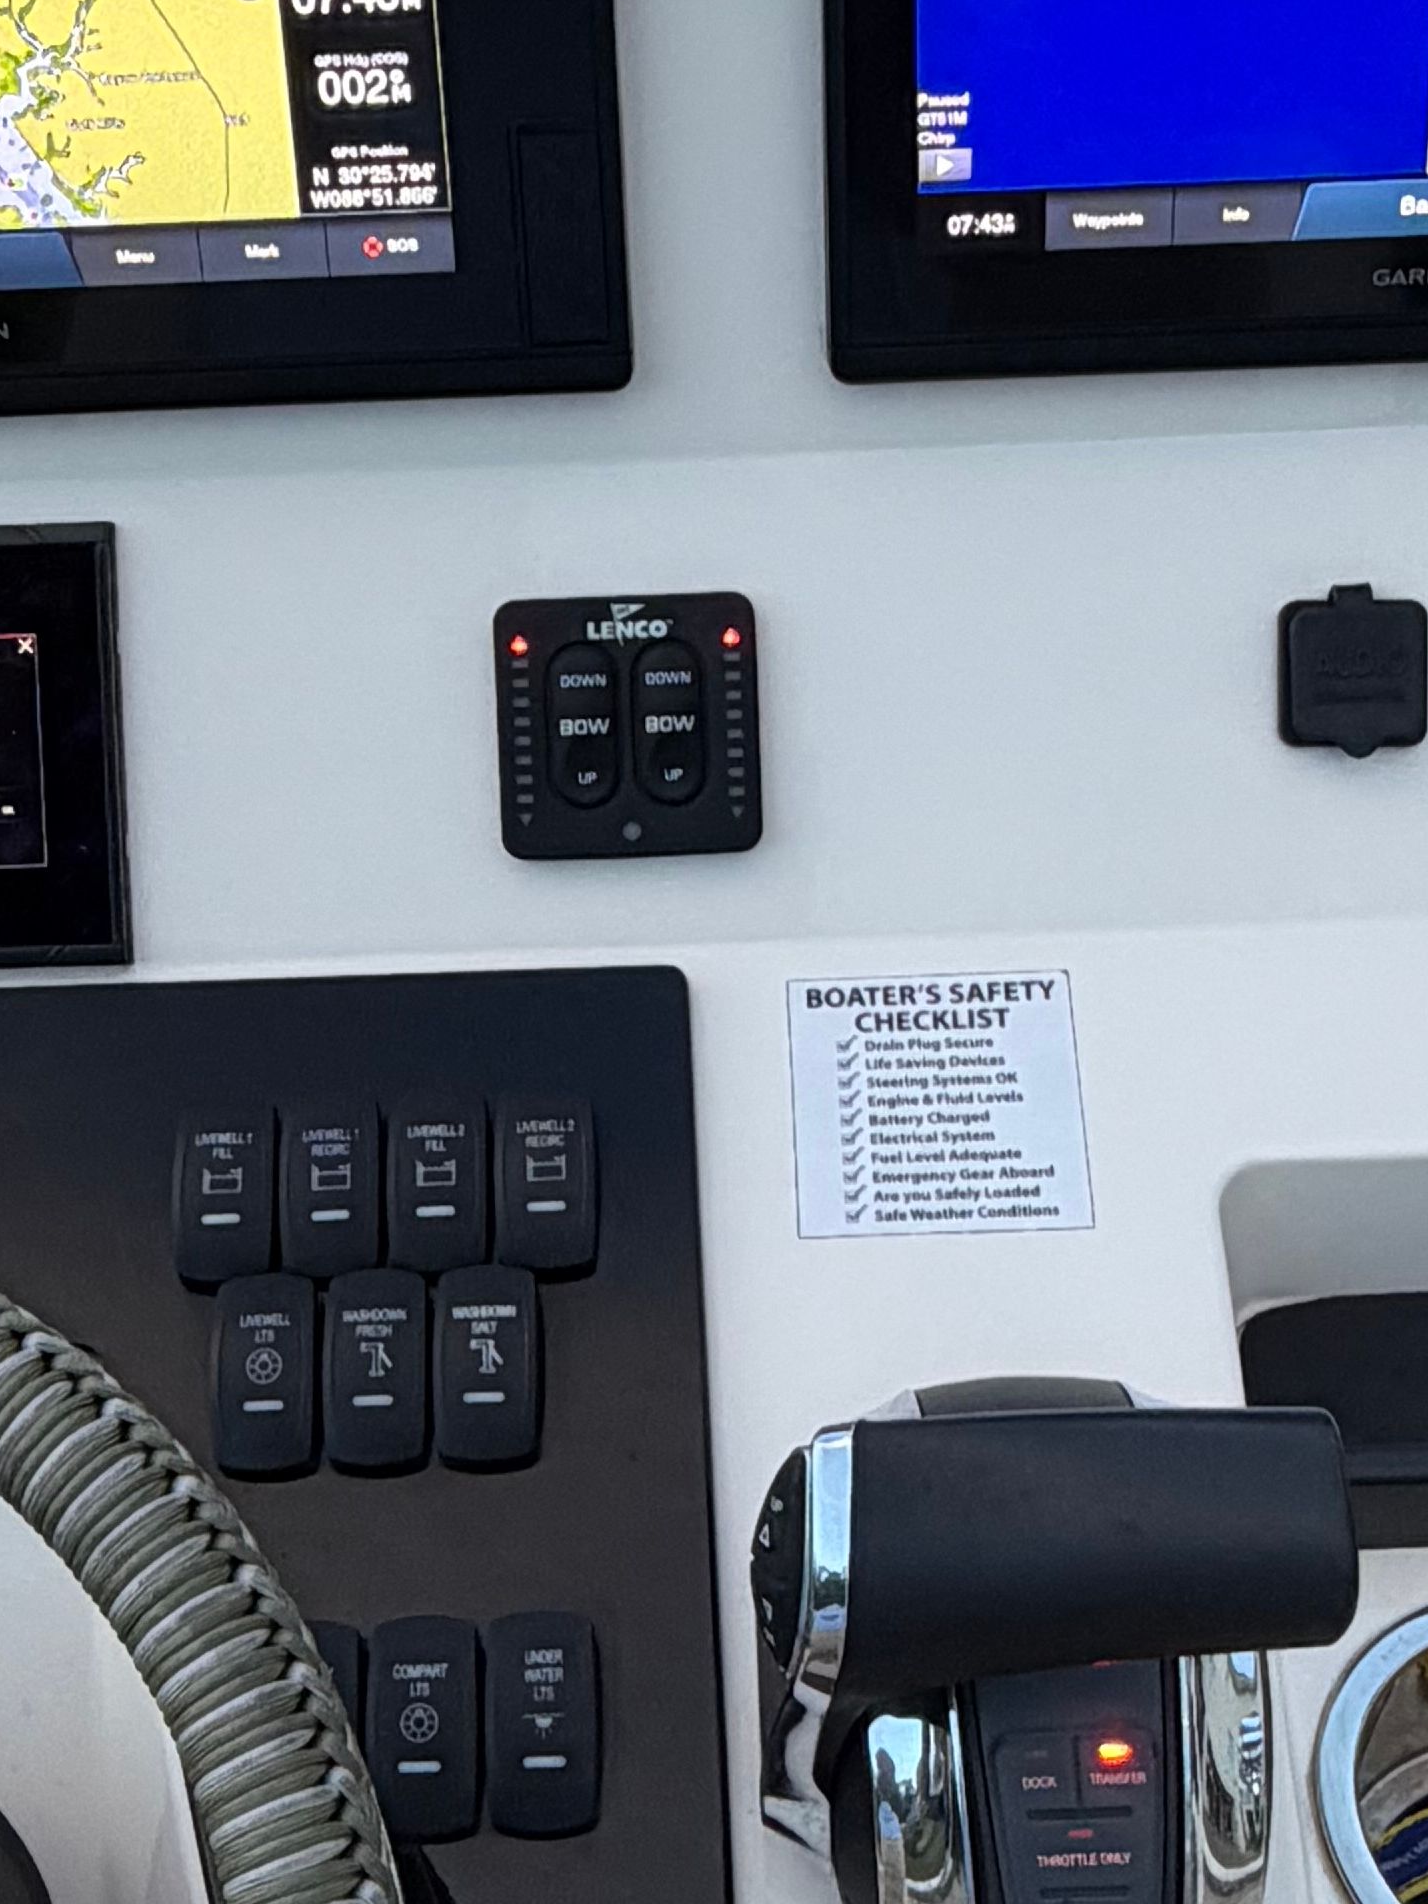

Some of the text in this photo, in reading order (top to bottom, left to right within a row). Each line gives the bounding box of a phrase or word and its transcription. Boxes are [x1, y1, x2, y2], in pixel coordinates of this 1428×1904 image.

[317, 68, 390, 106] 002
[948, 214, 1003, 237] 07:43
[587, 619, 668, 641] LENCO
[560, 674, 607, 689] DOWN
[645, 671, 692, 686] DOWN
[559, 718, 611, 737] BOW
[645, 715, 695, 734] BOW
[578, 771, 597, 785] UP
[664, 767, 684, 782] UP
[806, 980, 1055, 1008] BOATER'S SAFETY
[855, 1007, 1010, 1033] CHECKLIST
[864, 1036, 994, 1053] Drain Plug Secure
[865, 1053, 1005, 1071] Life Saving Devices
[866, 1072, 1018, 1091] Steering Systems OK
[867, 1094, 919, 1109] Engine
[936, 1091, 974, 1104] Fluid
[977, 1090, 1024, 1103] Levels
[869, 1110, 990, 1127] Battery Charged
[870, 1129, 996, 1145] Electrical System
[871, 1148, 1022, 1164] Fuel Level Adequate
[872, 1165, 1055, 1185] Emergency Gear Aboard
[873, 1184, 1041, 1204] Are you Safely Loaded
[874, 1204, 1060, 1222] Safe Weather Conditions
[523, 1648, 564, 1665] UNDER
[523, 1666, 564, 1684] WATER
[1022, 1775, 1058, 1791] DOCK
[1036, 1851, 1133, 1869] THROTTLE ONLY
